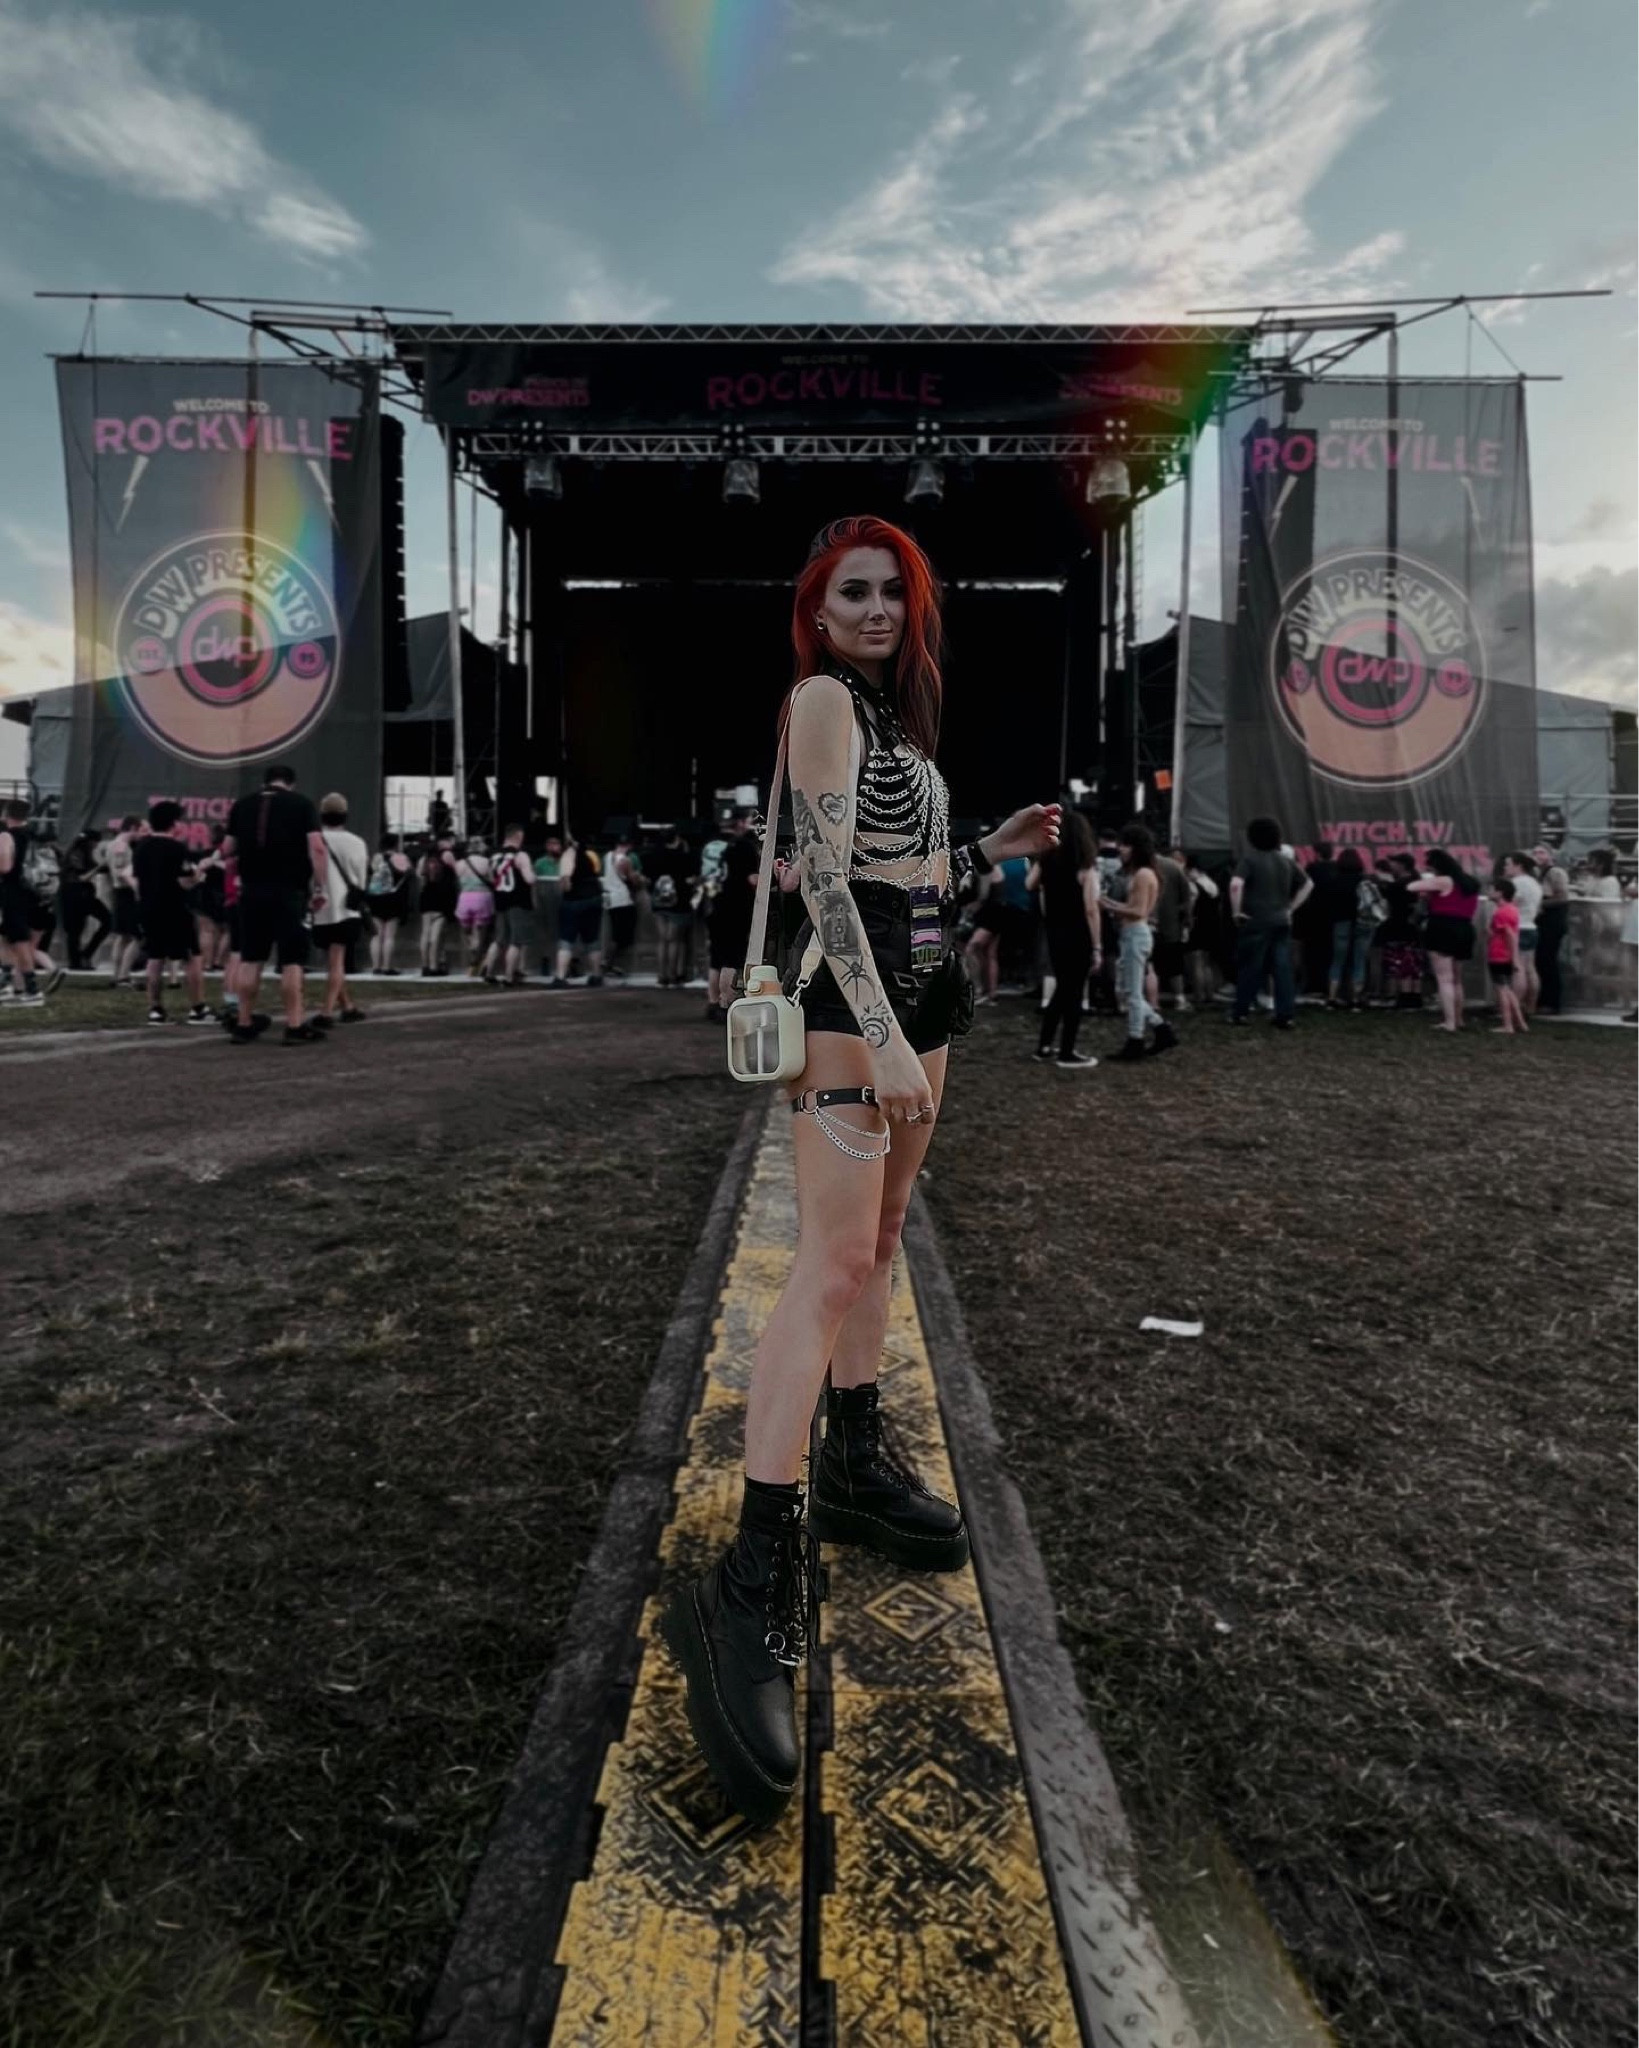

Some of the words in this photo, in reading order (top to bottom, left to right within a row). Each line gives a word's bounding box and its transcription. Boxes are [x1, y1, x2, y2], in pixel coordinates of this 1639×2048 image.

[173, 398, 247, 413] WELCOME
[249, 399, 270, 414] TO
[706, 368, 944, 411] ROCKVILLE
[94, 414, 354, 461] ROCKVILLE
[1330, 418, 1398, 431] WELCOME
[1404, 419, 1424, 432] TO
[1252, 434, 1502, 475] ROCKVILLE
